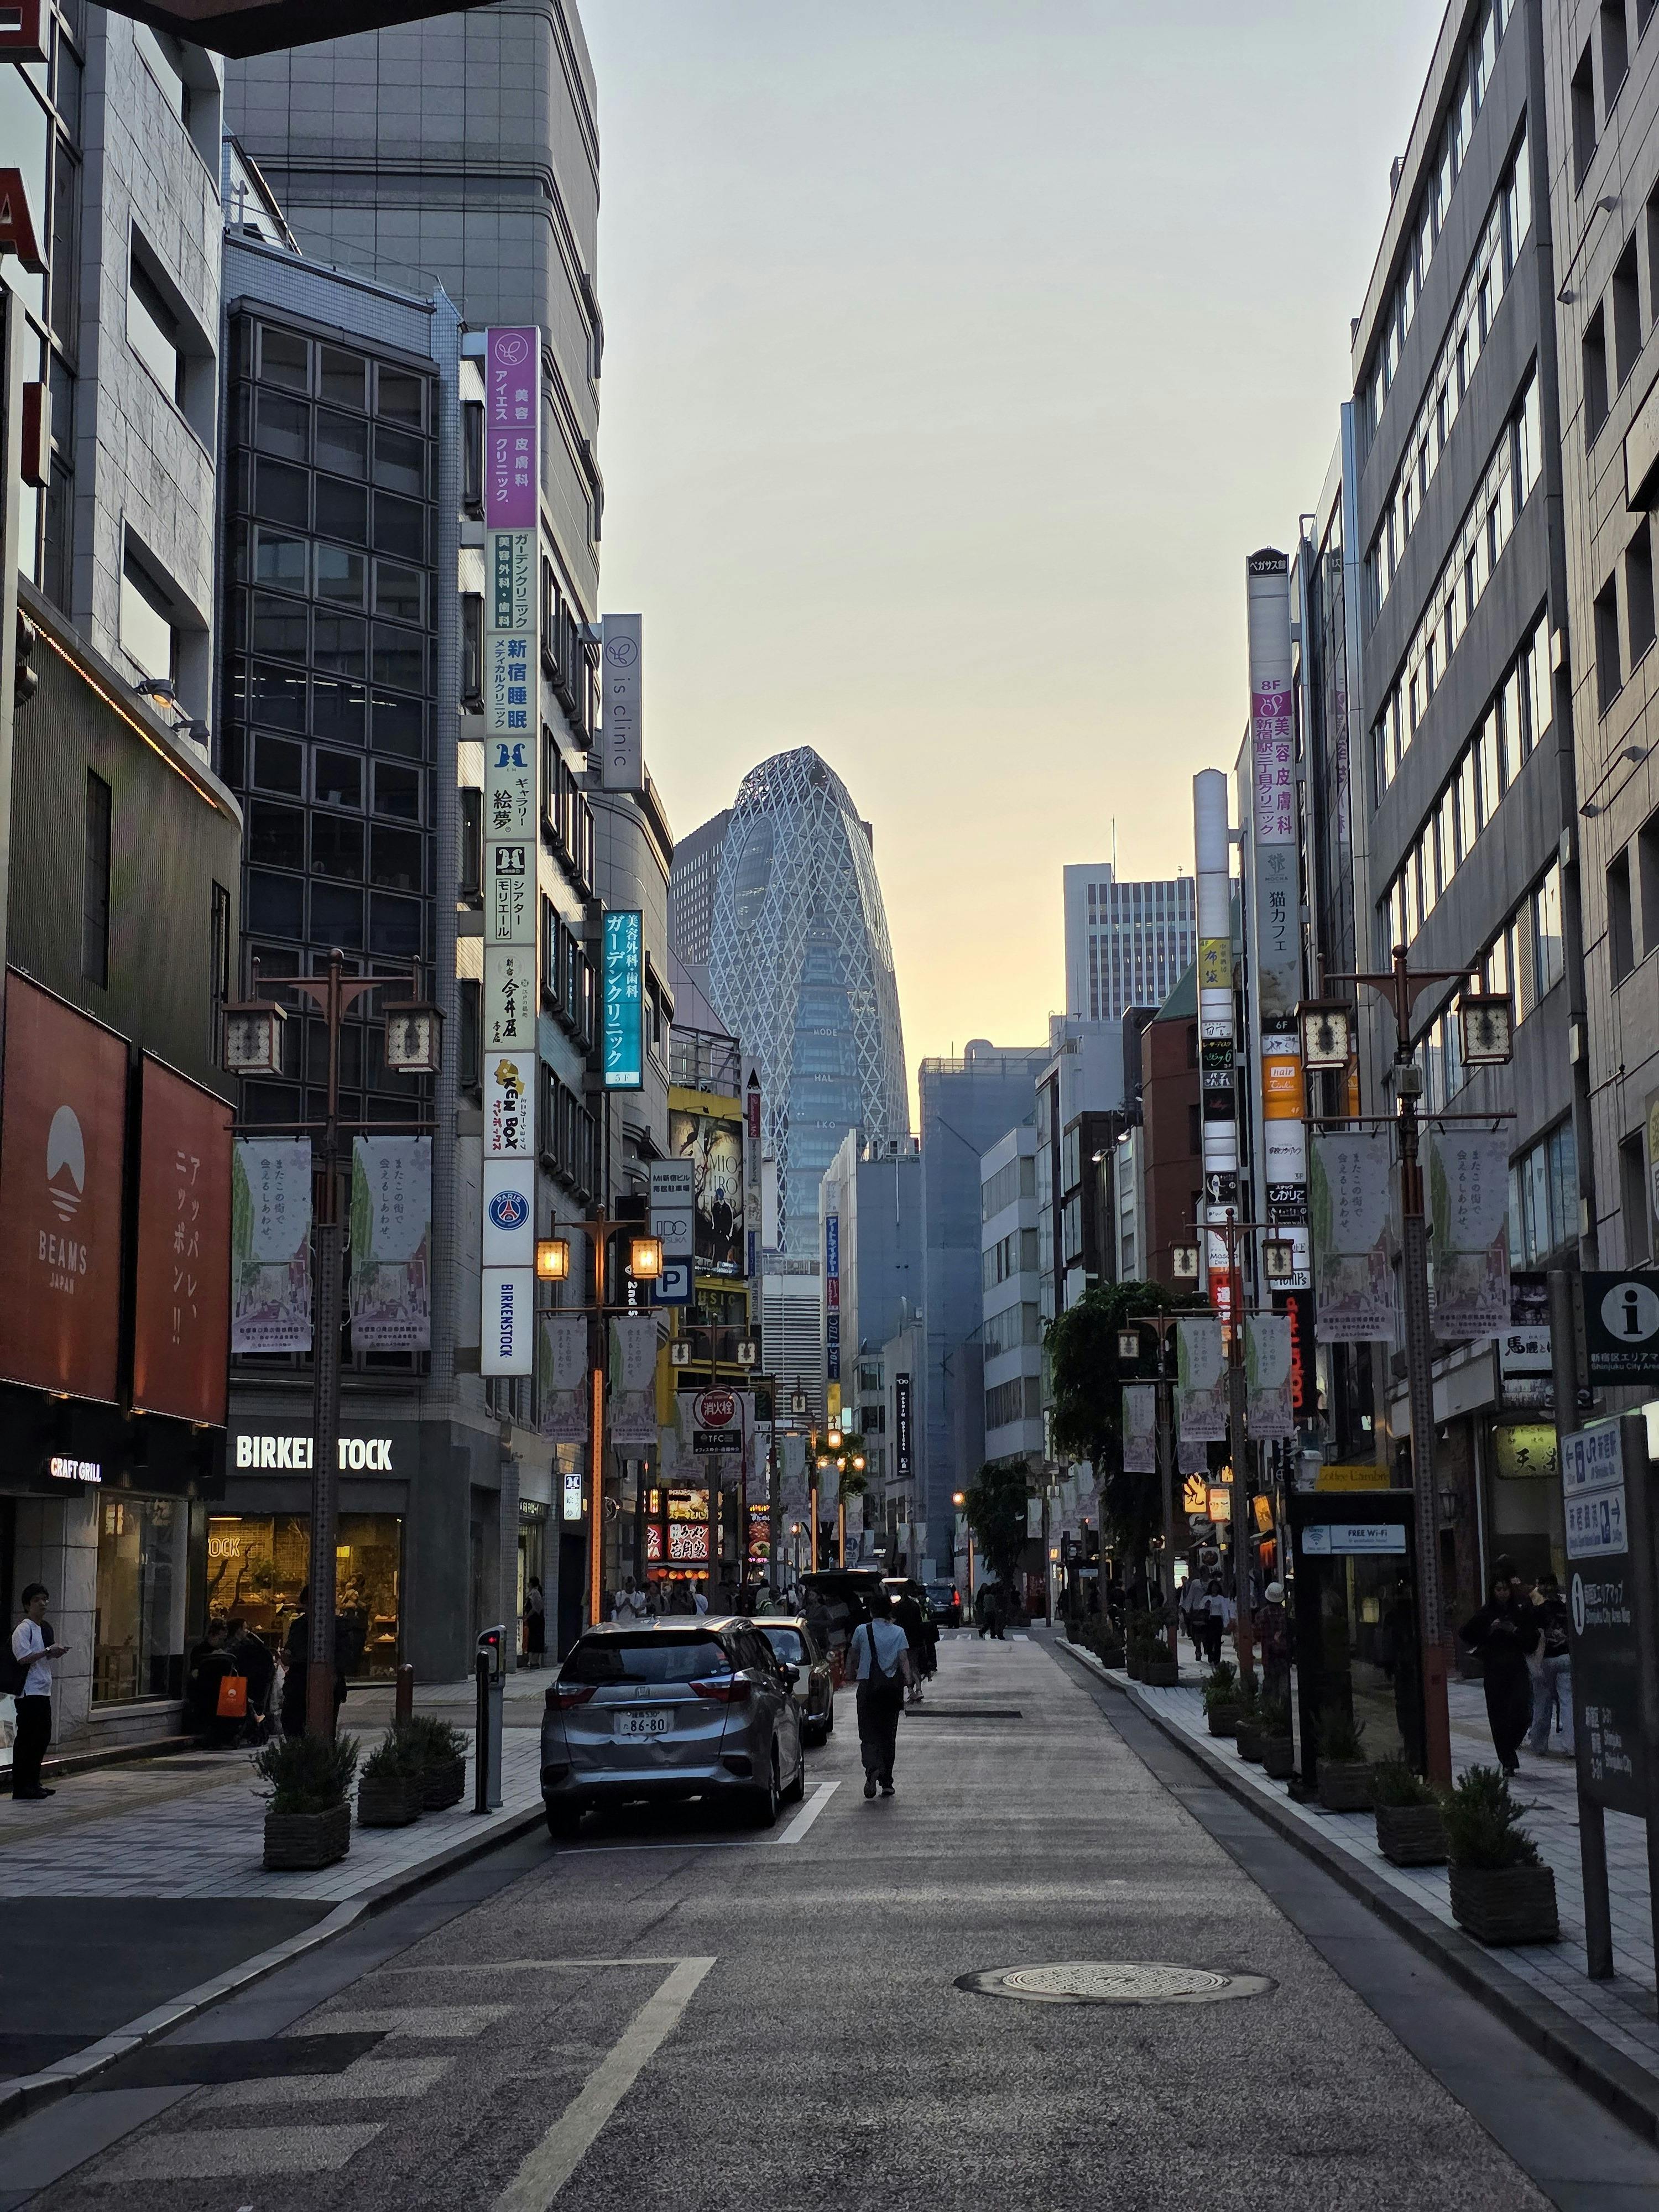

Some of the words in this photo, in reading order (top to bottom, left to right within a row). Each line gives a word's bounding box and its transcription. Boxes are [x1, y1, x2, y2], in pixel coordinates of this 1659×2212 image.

[495, 370, 508, 421] アイエス
[514, 389, 529, 420] 美容
[515, 438, 529, 487] 皮膚科
[498, 536, 510, 627] 美容外科・歯科
[514, 534, 529, 629] ガーデンクリニック
[1250, 560, 1286, 572] ペガサス館
[494, 639, 506, 729] メディカルクリニック
[508, 639, 527, 729] 新宿睡眠
[613, 676, 630, 695] is
[1261, 680, 1280, 691] 8F
[613, 706, 632, 767] clinic
[1256, 718, 1273, 834] 新宿駅三丁目クリニック
[1275, 717, 1292, 834] 美容皮膚科
[493, 790, 512, 830] 絵夢
[515, 778, 529, 826] ギャラリー
[497, 881, 510, 937] モリエール
[513, 880, 524, 925] シアター
[1269, 891, 1287, 951] 猫カフェ
[627, 915, 639, 999] 美容外科・歯科
[606, 915, 625, 1067] ガーデンクリニック
[813, 1028, 838, 1037] MODE
[1276, 1020, 1288, 1029] 6F
[814, 1073, 834, 1082] HAL
[1274, 1068, 1292, 1076] hair
[503, 1076, 519, 1112] KEN
[493, 1100, 502, 1151] ケンボックス
[503, 1117, 518, 1150] BOX
[817, 1120, 836, 1129] IKO
[275, 1159, 285, 1224] またこの街で
[394, 1159, 404, 1224] またこの街で
[496, 1193, 521, 1203] PARIS
[1351, 1152, 1363, 1217] またこの街で
[1470, 1149, 1481, 1215] またこの街で
[656, 1220, 687, 1236] IDC
[39, 1229, 87, 1275] BEAMS
[49, 1272, 75, 1295] JAPAN
[628, 1281, 638, 1306] 2nd
[663, 1270, 680, 1292] P
[499, 1284, 514, 1357] BIRKENSTOCK
[829, 1318, 838, 1341] TBC
[1591, 1363, 1624, 1372] Shinjuku
[1626, 1363, 1641, 1371] City
[704, 1400, 733, 1416] 消火栓
[50, 1457, 78, 1479] CRAFT
[78, 1462, 102, 1482] GRILL
[236, 1436, 393, 1470] BIRKETOCK
[208, 1537, 240, 1557] OCK
[630, 1719, 665, 1731] 86-80
